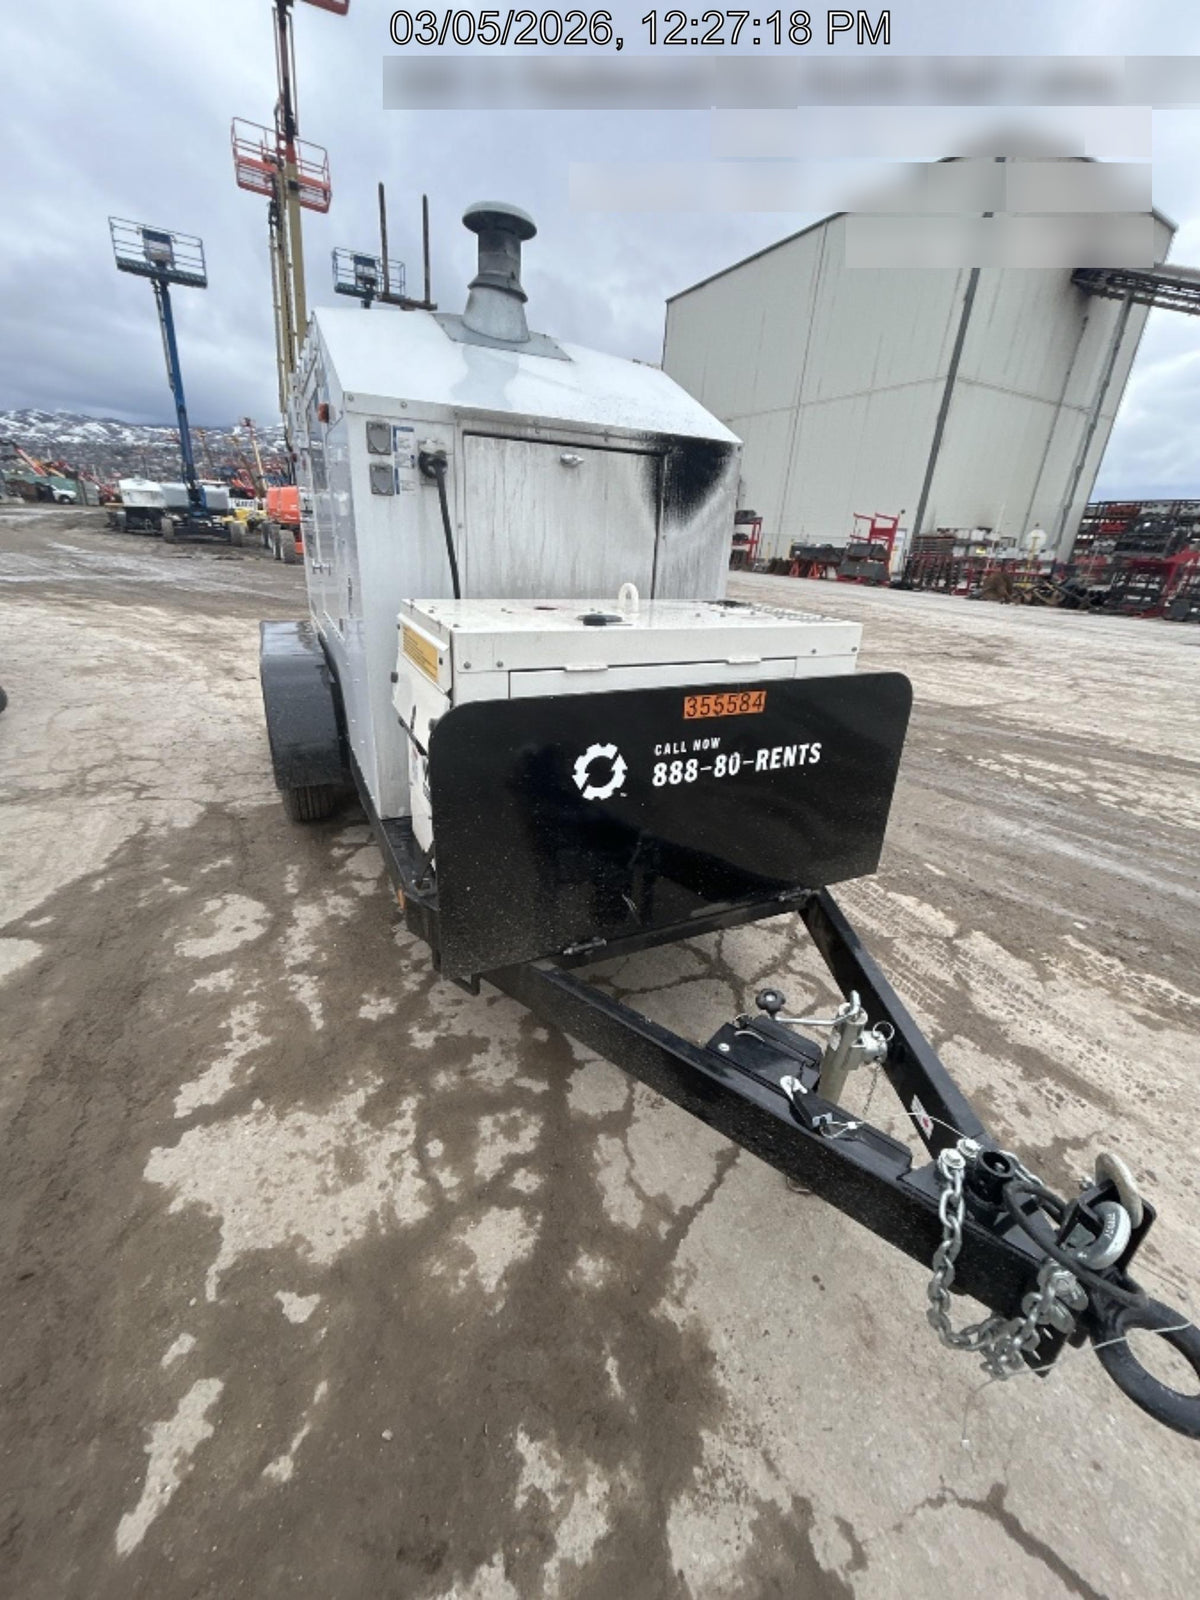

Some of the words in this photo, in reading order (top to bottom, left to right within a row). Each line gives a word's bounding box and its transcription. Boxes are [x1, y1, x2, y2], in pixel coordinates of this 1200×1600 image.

[686, 692, 764, 717] 355584
[654, 741, 687, 756] CALL
[693, 737, 721, 751] NOW
[652, 742, 823, 787] 888-80-RENTS
